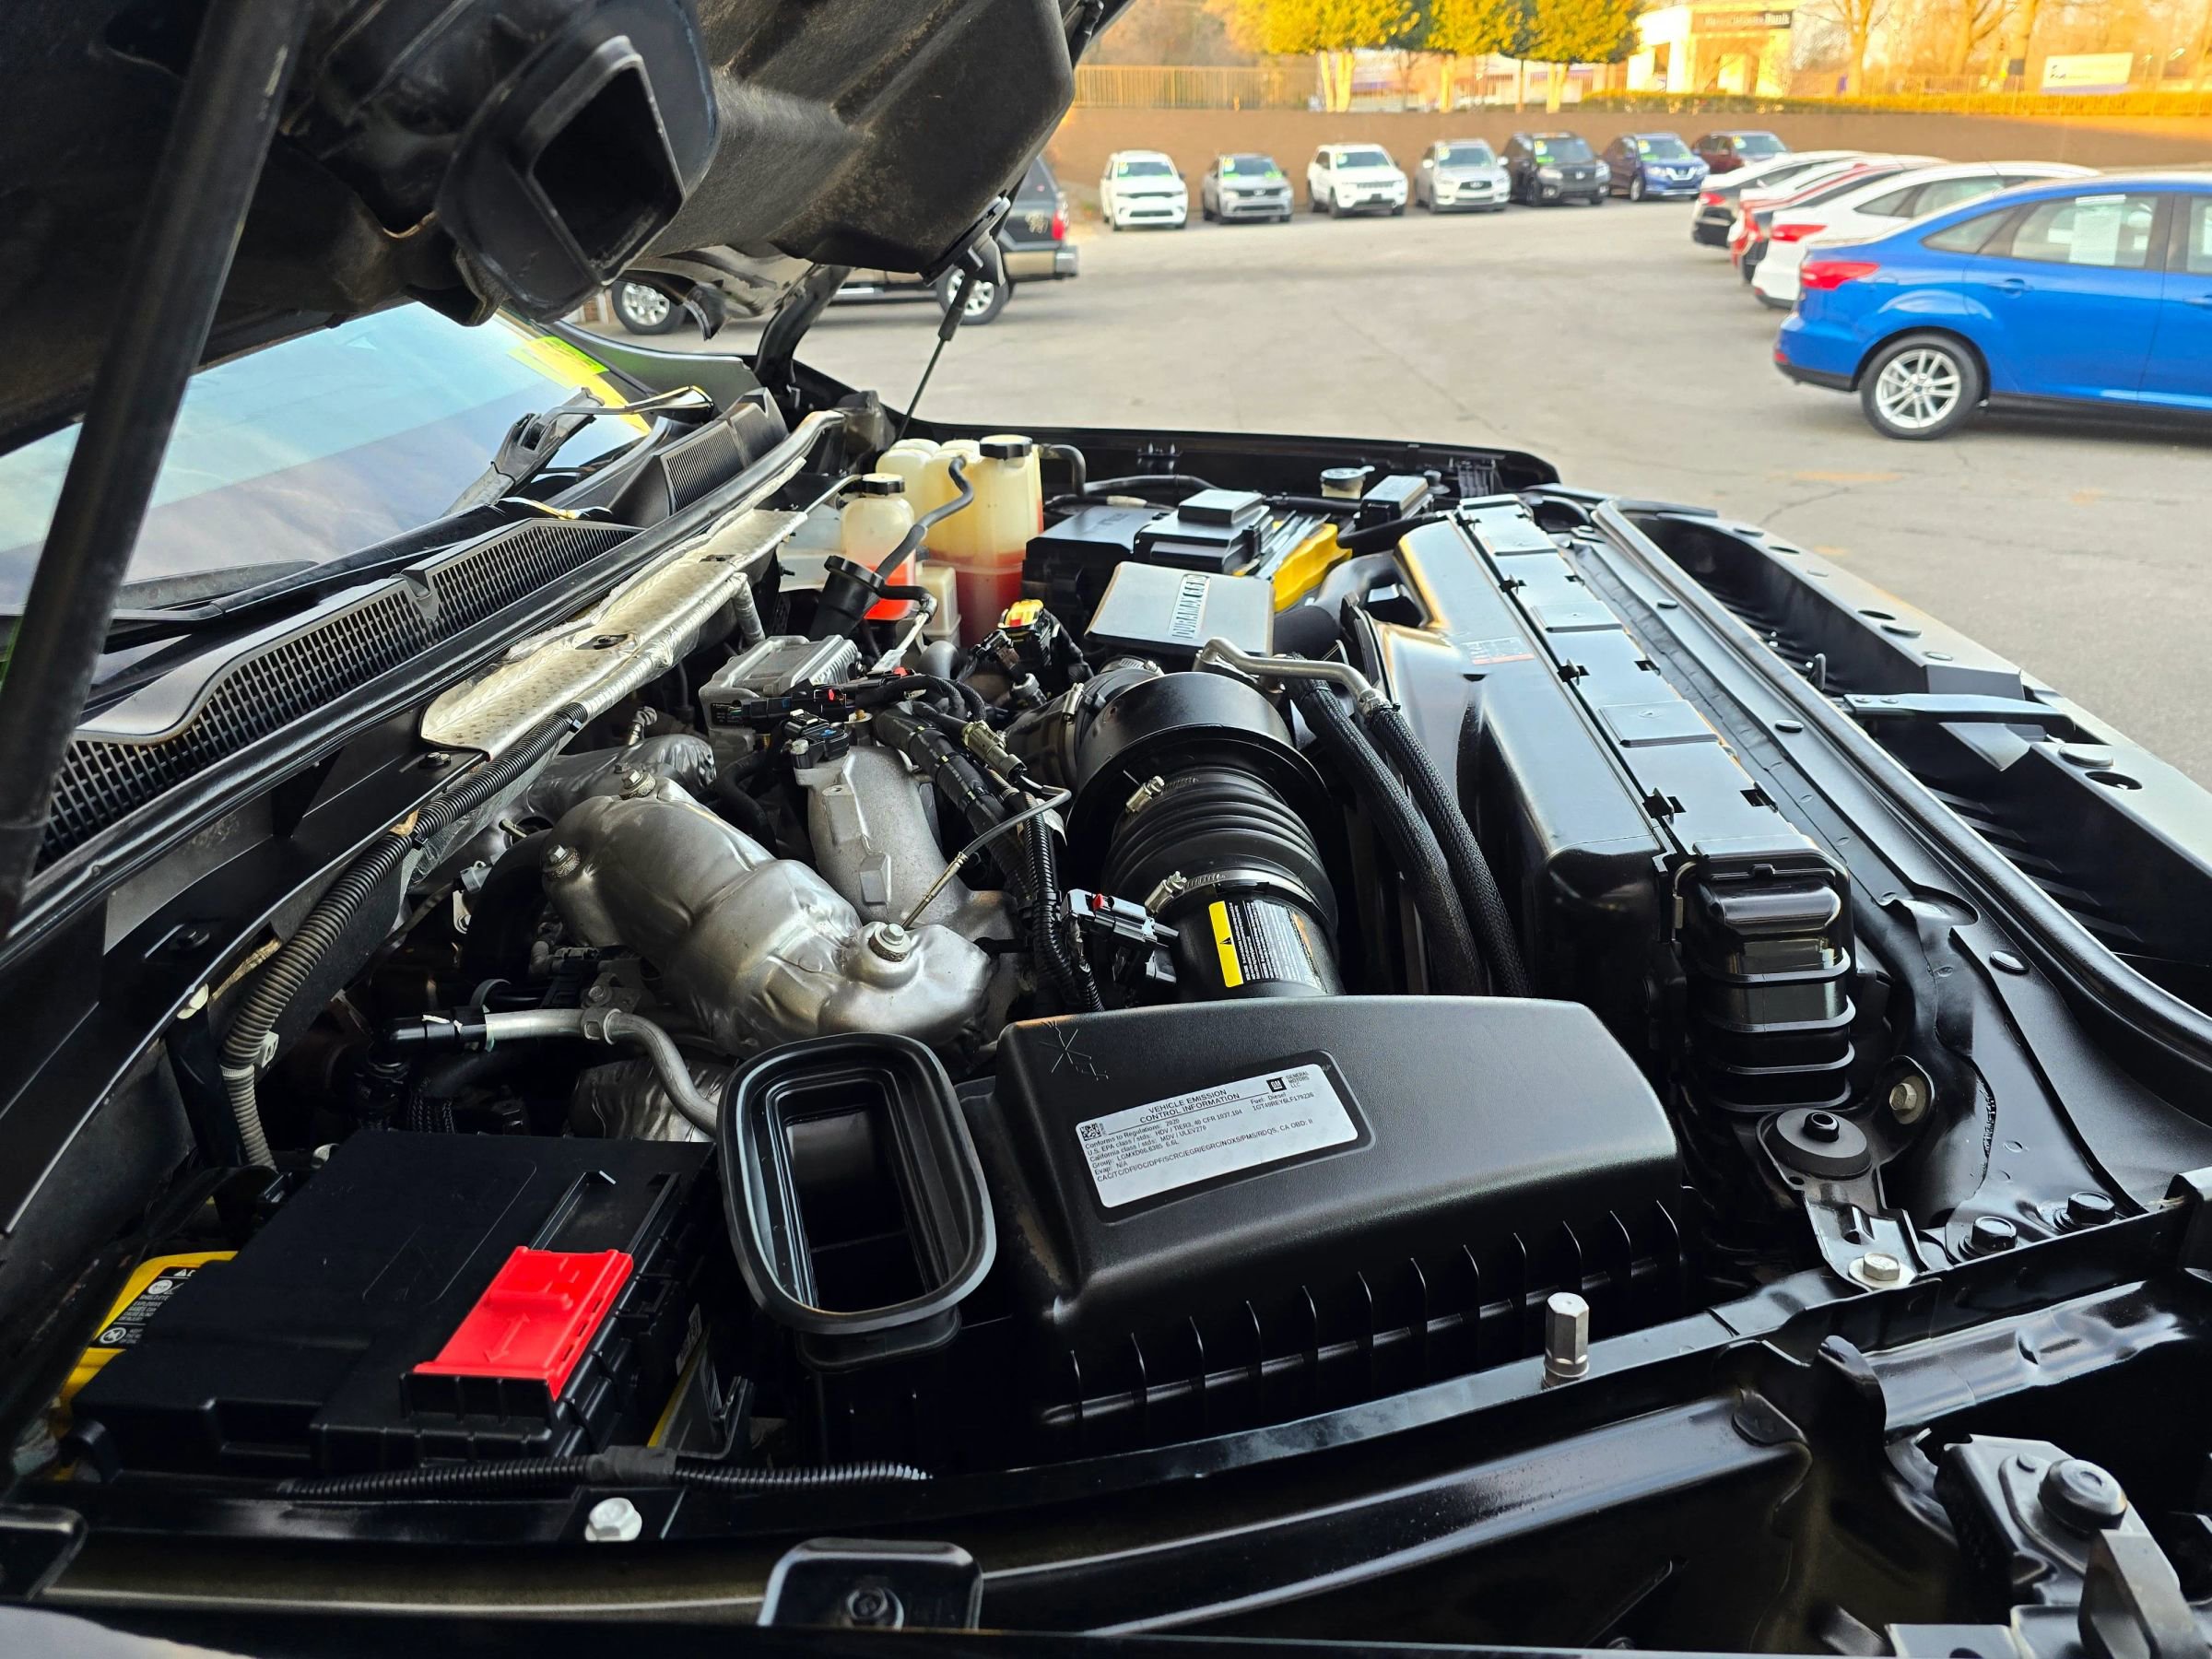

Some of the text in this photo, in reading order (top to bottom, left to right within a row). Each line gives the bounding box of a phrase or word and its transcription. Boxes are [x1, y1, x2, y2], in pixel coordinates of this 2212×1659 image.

[1172, 597, 1201, 639] DURAMAX
[1140, 1093, 1241, 1123] CONTROL INFORMATION
[1149, 1089, 1227, 1113] VEHICLE EMISSION
[1268, 1092, 1287, 1100] Diesel
[1086, 1138, 1115, 1149] Conforms
[1165, 1118, 1181, 1126] 2020
[1088, 1148, 1100, 1157] U.S.
[1101, 1144, 1115, 1152] EPA
[1116, 1139, 1132, 1147] class
[1155, 1127, 1169, 1136] HDV
[1203, 1115, 1217, 1124] CFR
[1280, 1122, 1290, 1131] CA
[1089, 1150, 1120, 1162] California
[1121, 1145, 1137, 1154] class
[1160, 1133, 1175, 1142] MDV
[1092, 1159, 1114, 1170] Group:
[1166, 1139, 1181, 1147] 6.6L
[1095, 1161, 1128, 1176] Evap: N/A
